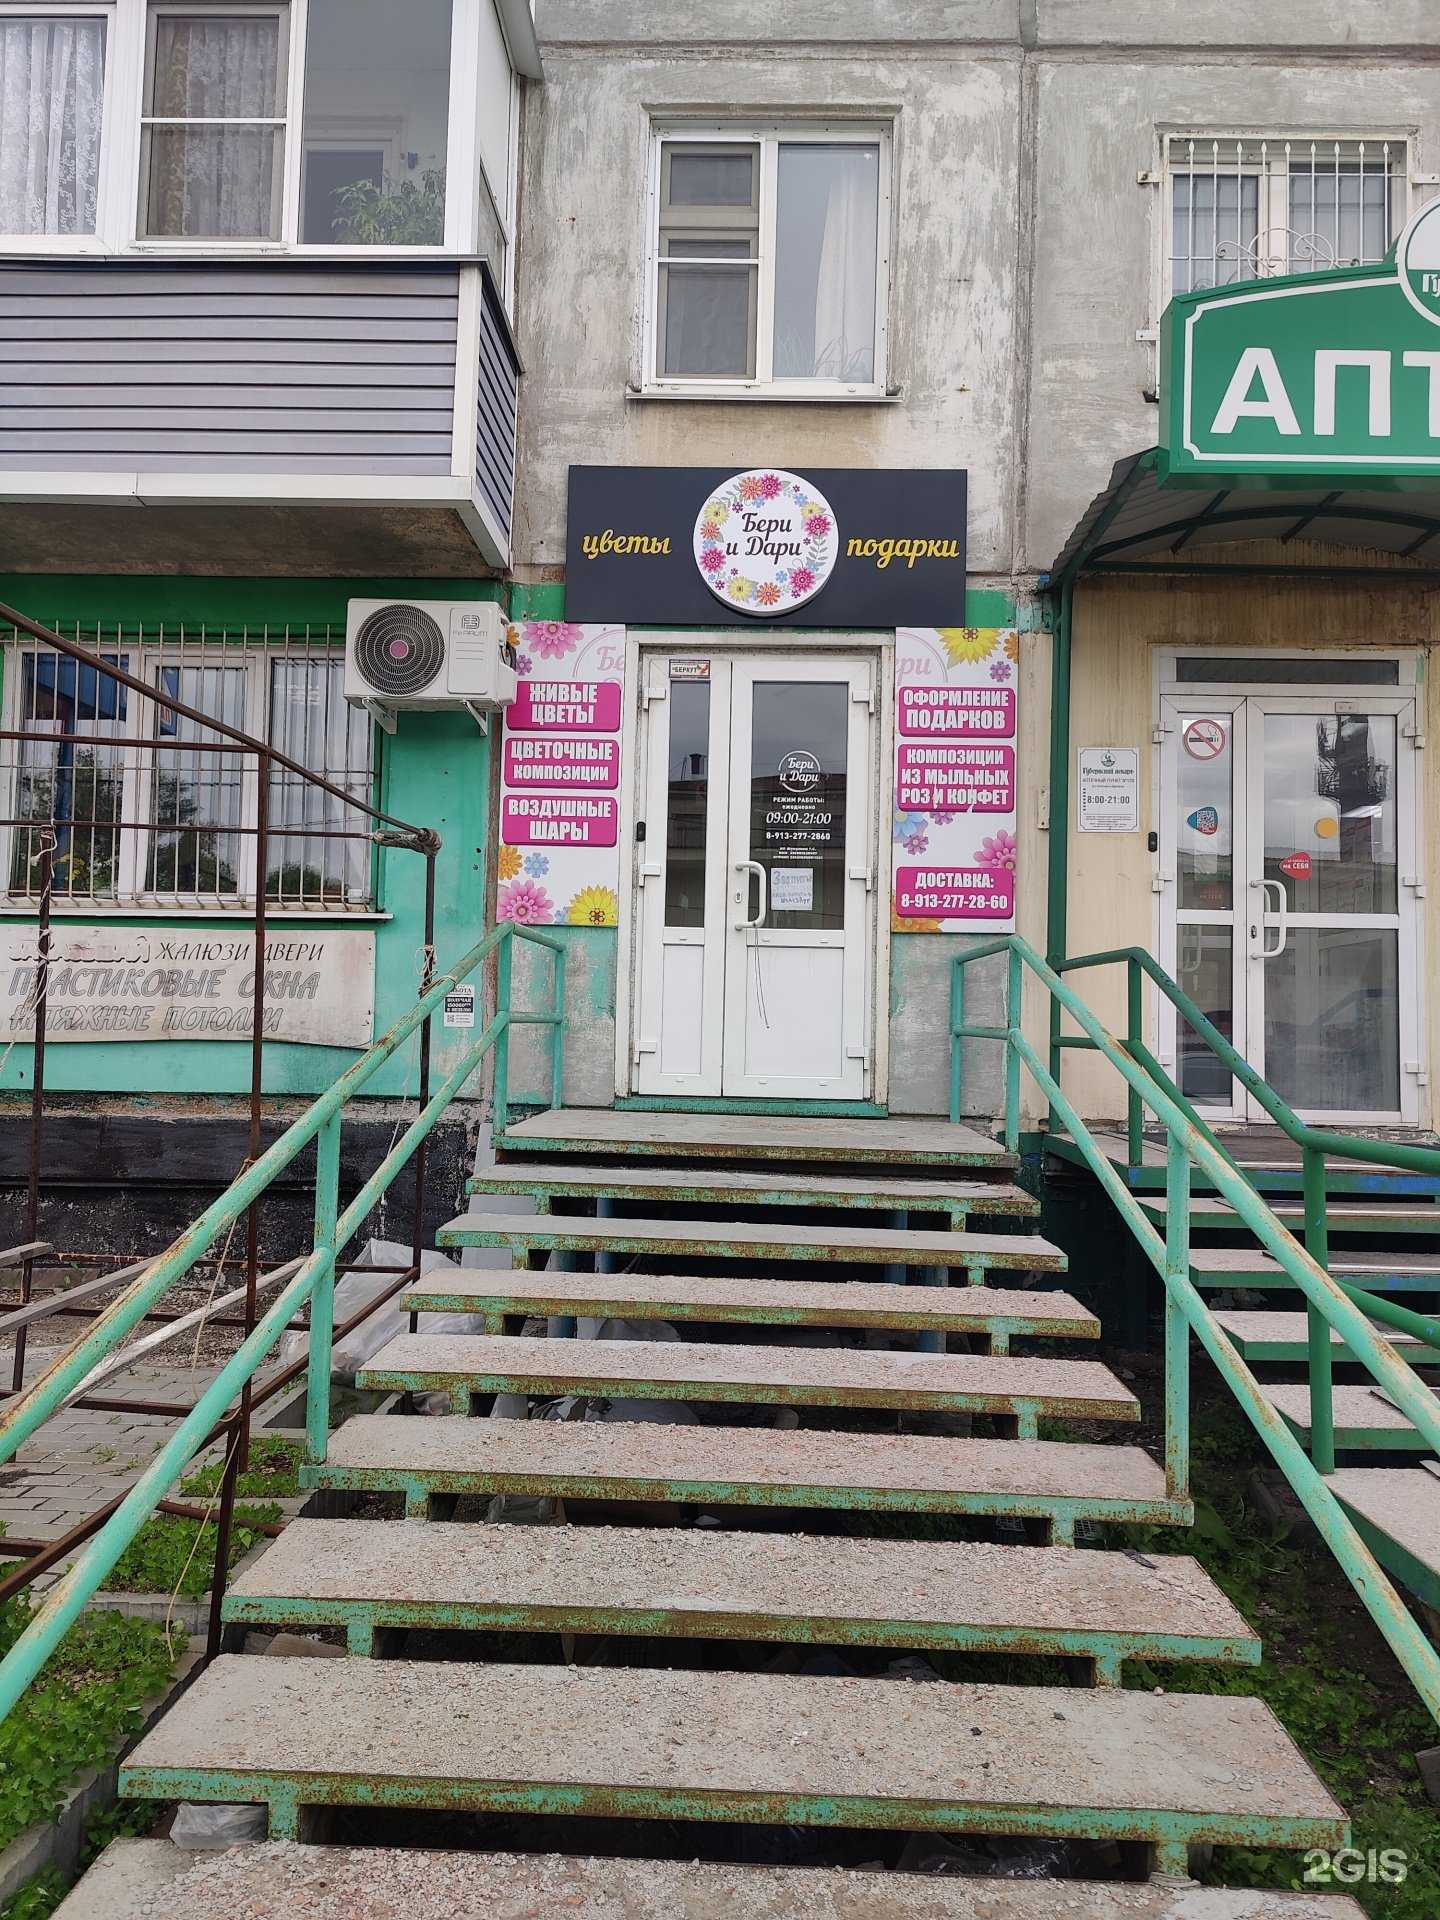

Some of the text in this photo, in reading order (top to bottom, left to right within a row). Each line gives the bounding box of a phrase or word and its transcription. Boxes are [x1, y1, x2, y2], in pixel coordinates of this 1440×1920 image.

[741, 512, 793, 544] Бери
[582, 529, 673, 560] цветы
[725, 535, 803, 565] и Дари
[846, 536, 960, 569] подарки
[528, 683, 598, 703] ЖИВЫЕ
[903, 689, 1009, 707] ОФОРМЛЕНИЕ
[531, 704, 595, 725] ЦВЕТЫ
[906, 709, 1006, 731] ПОДАРКОВ
[511, 741, 613, 761] ЦВЕТОЧНЫЕ
[906, 748, 1004, 766] КОМПОЗИЦИИ
[513, 764, 609, 782] КОМПОЗИЦИИ
[788, 758, 814, 773] Бери
[789, 770, 819, 786] Дари
[901, 768, 1009, 786] ИЗ МЫЛЬНЫХ
[901, 787, 1009, 806] РОЗ И КОНФЕТ
[1087, 795, 1130, 804] 8:00-21:00
[508, 798, 612, 819] ВОЗДУШНЫЕ
[766, 812, 832, 825] 09:00-21:00
[529, 820, 589, 841] ШАРЫ
[766, 831, 831, 841] 8-913-277-2860
[914, 872, 995, 889] ДОСТАВКА:
[901, 893, 1008, 909] 8-913-277-28-60
[155, 942, 250, 961] ЖАЛЮЗИ
